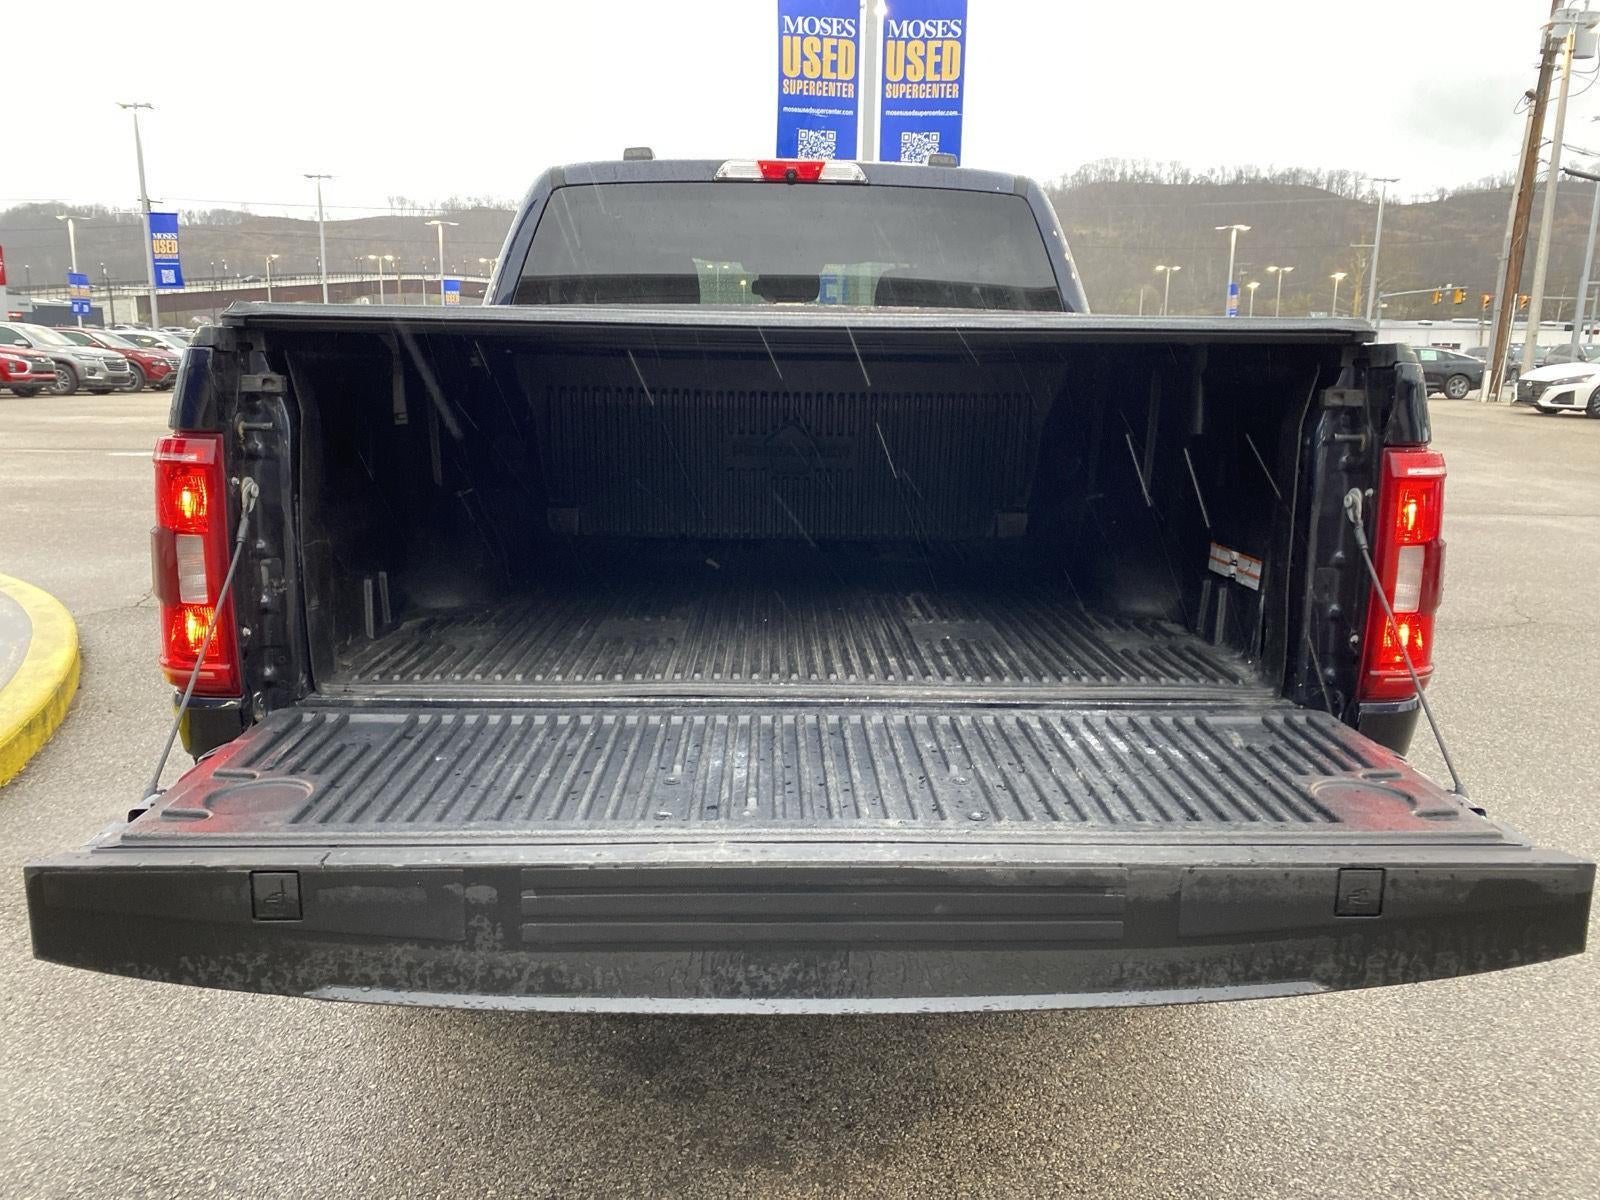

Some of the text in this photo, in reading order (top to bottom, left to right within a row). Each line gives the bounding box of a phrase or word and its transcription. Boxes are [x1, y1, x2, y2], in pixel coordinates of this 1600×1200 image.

[783, 16, 855, 36] MOSES
[888, 19, 962, 39] MOSES
[782, 37, 855, 80] USED
[887, 41, 961, 82] USED
[784, 80, 854, 98] SUPERCENTER
[886, 84, 958, 99] SUPERCENTER
[784, 107, 854, 116] mosesusedsupercenter.com
[153, 240, 178, 253] USED
